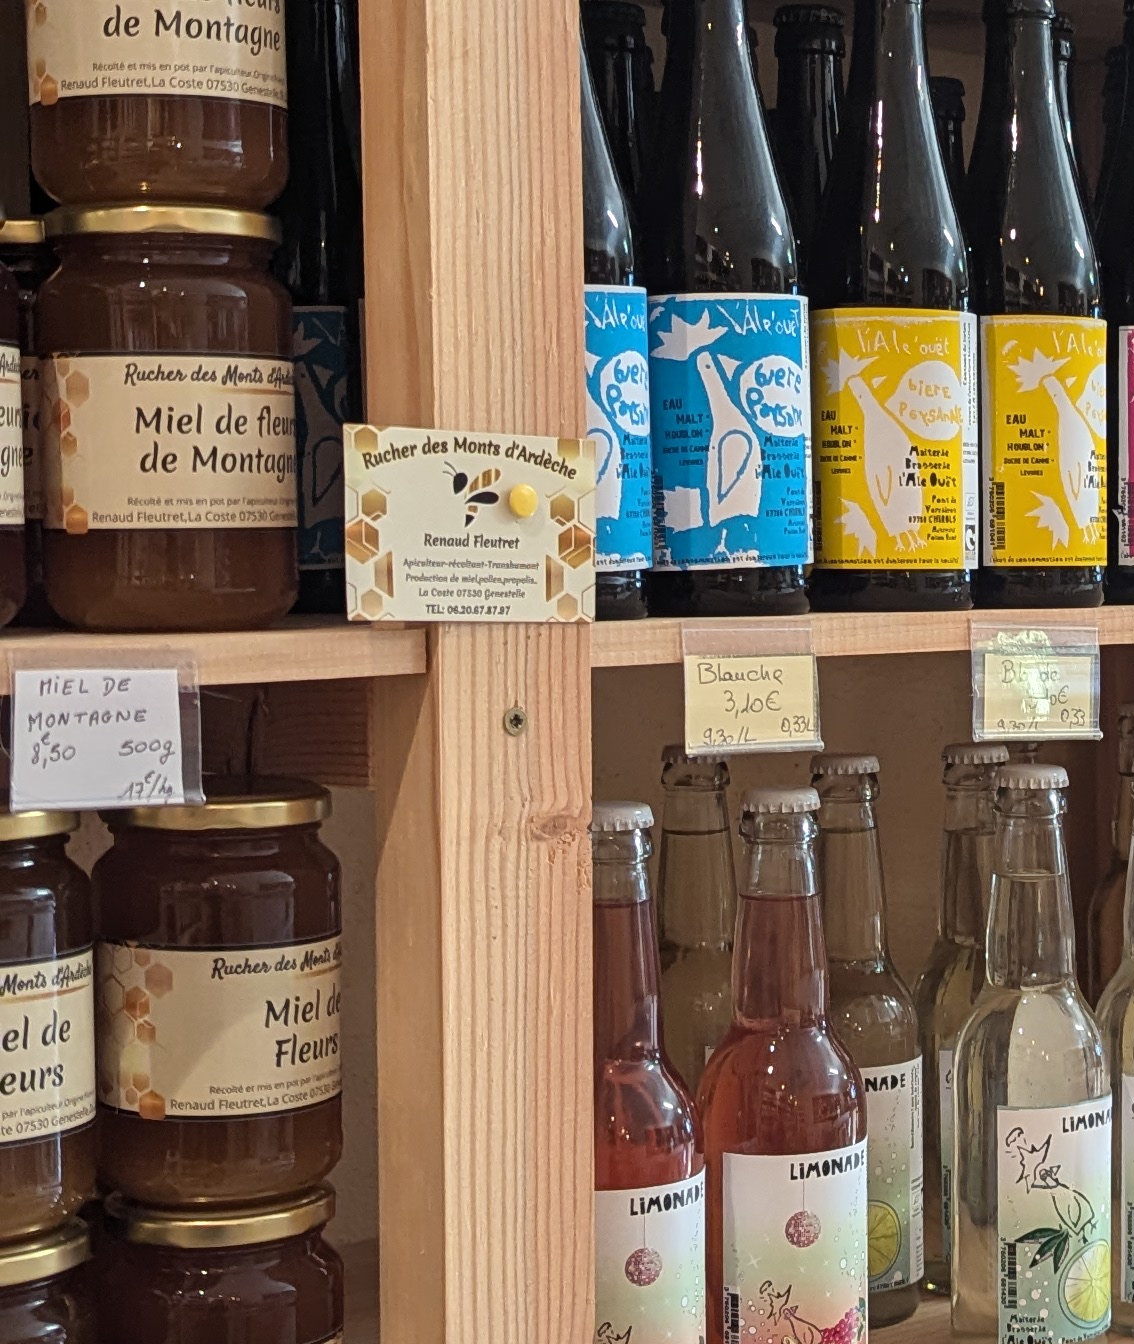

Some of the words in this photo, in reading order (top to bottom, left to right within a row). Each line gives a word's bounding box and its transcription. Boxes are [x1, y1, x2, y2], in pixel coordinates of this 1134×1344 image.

[103, 5, 140, 38] de
[154, 9, 281, 56] Montagne
[61, 77, 98, 91] Renaud
[169, 78, 204, 90] Coste
[124, 363, 187, 386] Rucher
[191, 364, 218, 383] des
[221, 366, 264, 387] Monts
[135, 405, 202, 435] Miel
[215, 406, 247, 436] de
[1006, 415, 1026, 424] EAU
[1019, 428, 1045, 438] MALT
[362, 442, 418, 470] Rucher
[422, 436, 448, 455] des
[453, 436, 501, 457] Monts
[505, 440, 577, 480] d'Ardèche
[423, 533, 470, 549] Renaud
[473, 533, 520, 549] Fleutret
[418, 588, 429, 597] La
[697, 662, 783, 685] Blanche
[103, 676, 131, 696] DE
[724, 690, 782, 719] 3,10€
[28, 709, 147, 732] MONTAGNE
[118, 739, 176, 765] 500g
[211, 957, 272, 980] Rucher
[274, 956, 297, 972] des
[300, 951, 331, 971] Monts
[265, 988, 321, 1029] Miel
[275, 1032, 339, 1068] Fleurs
